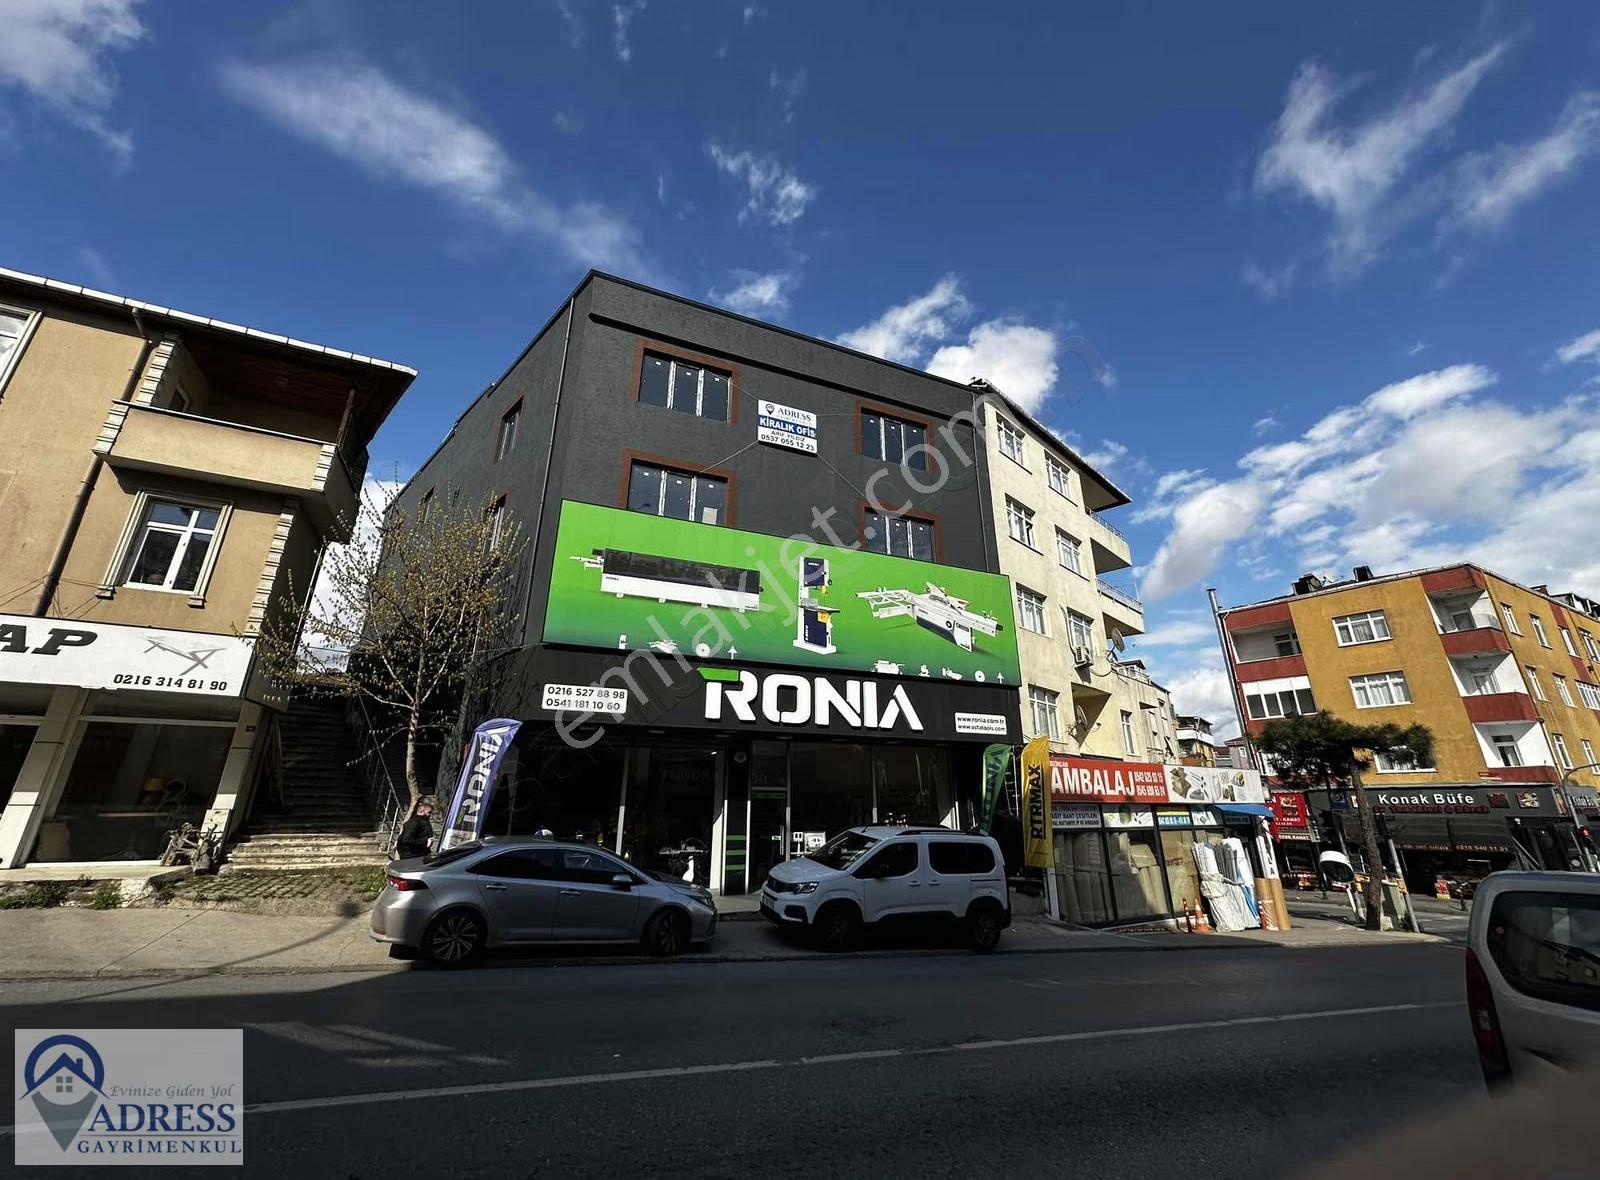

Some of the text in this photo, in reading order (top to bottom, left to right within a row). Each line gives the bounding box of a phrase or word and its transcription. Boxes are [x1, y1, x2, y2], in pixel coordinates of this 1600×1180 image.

[777, 408, 811, 421] ADRESS
[760, 417, 795, 432] KİRALIK
[796, 425, 816, 438] OFİS
[761, 434, 778, 442] 0537
[781, 438, 794, 446] 055
[113, 673, 228, 691] 0216 314 81 90
[547, 686, 625, 699] 0216 527 88 98
[697, 667, 924, 731] RONIA
[546, 698, 620, 711] 0541 181 10 60
[1051, 767, 1135, 796] AMBALAJ
[1027, 763, 1043, 839] RTRMAX
[1378, 793, 1474, 805] Konak Büfe
